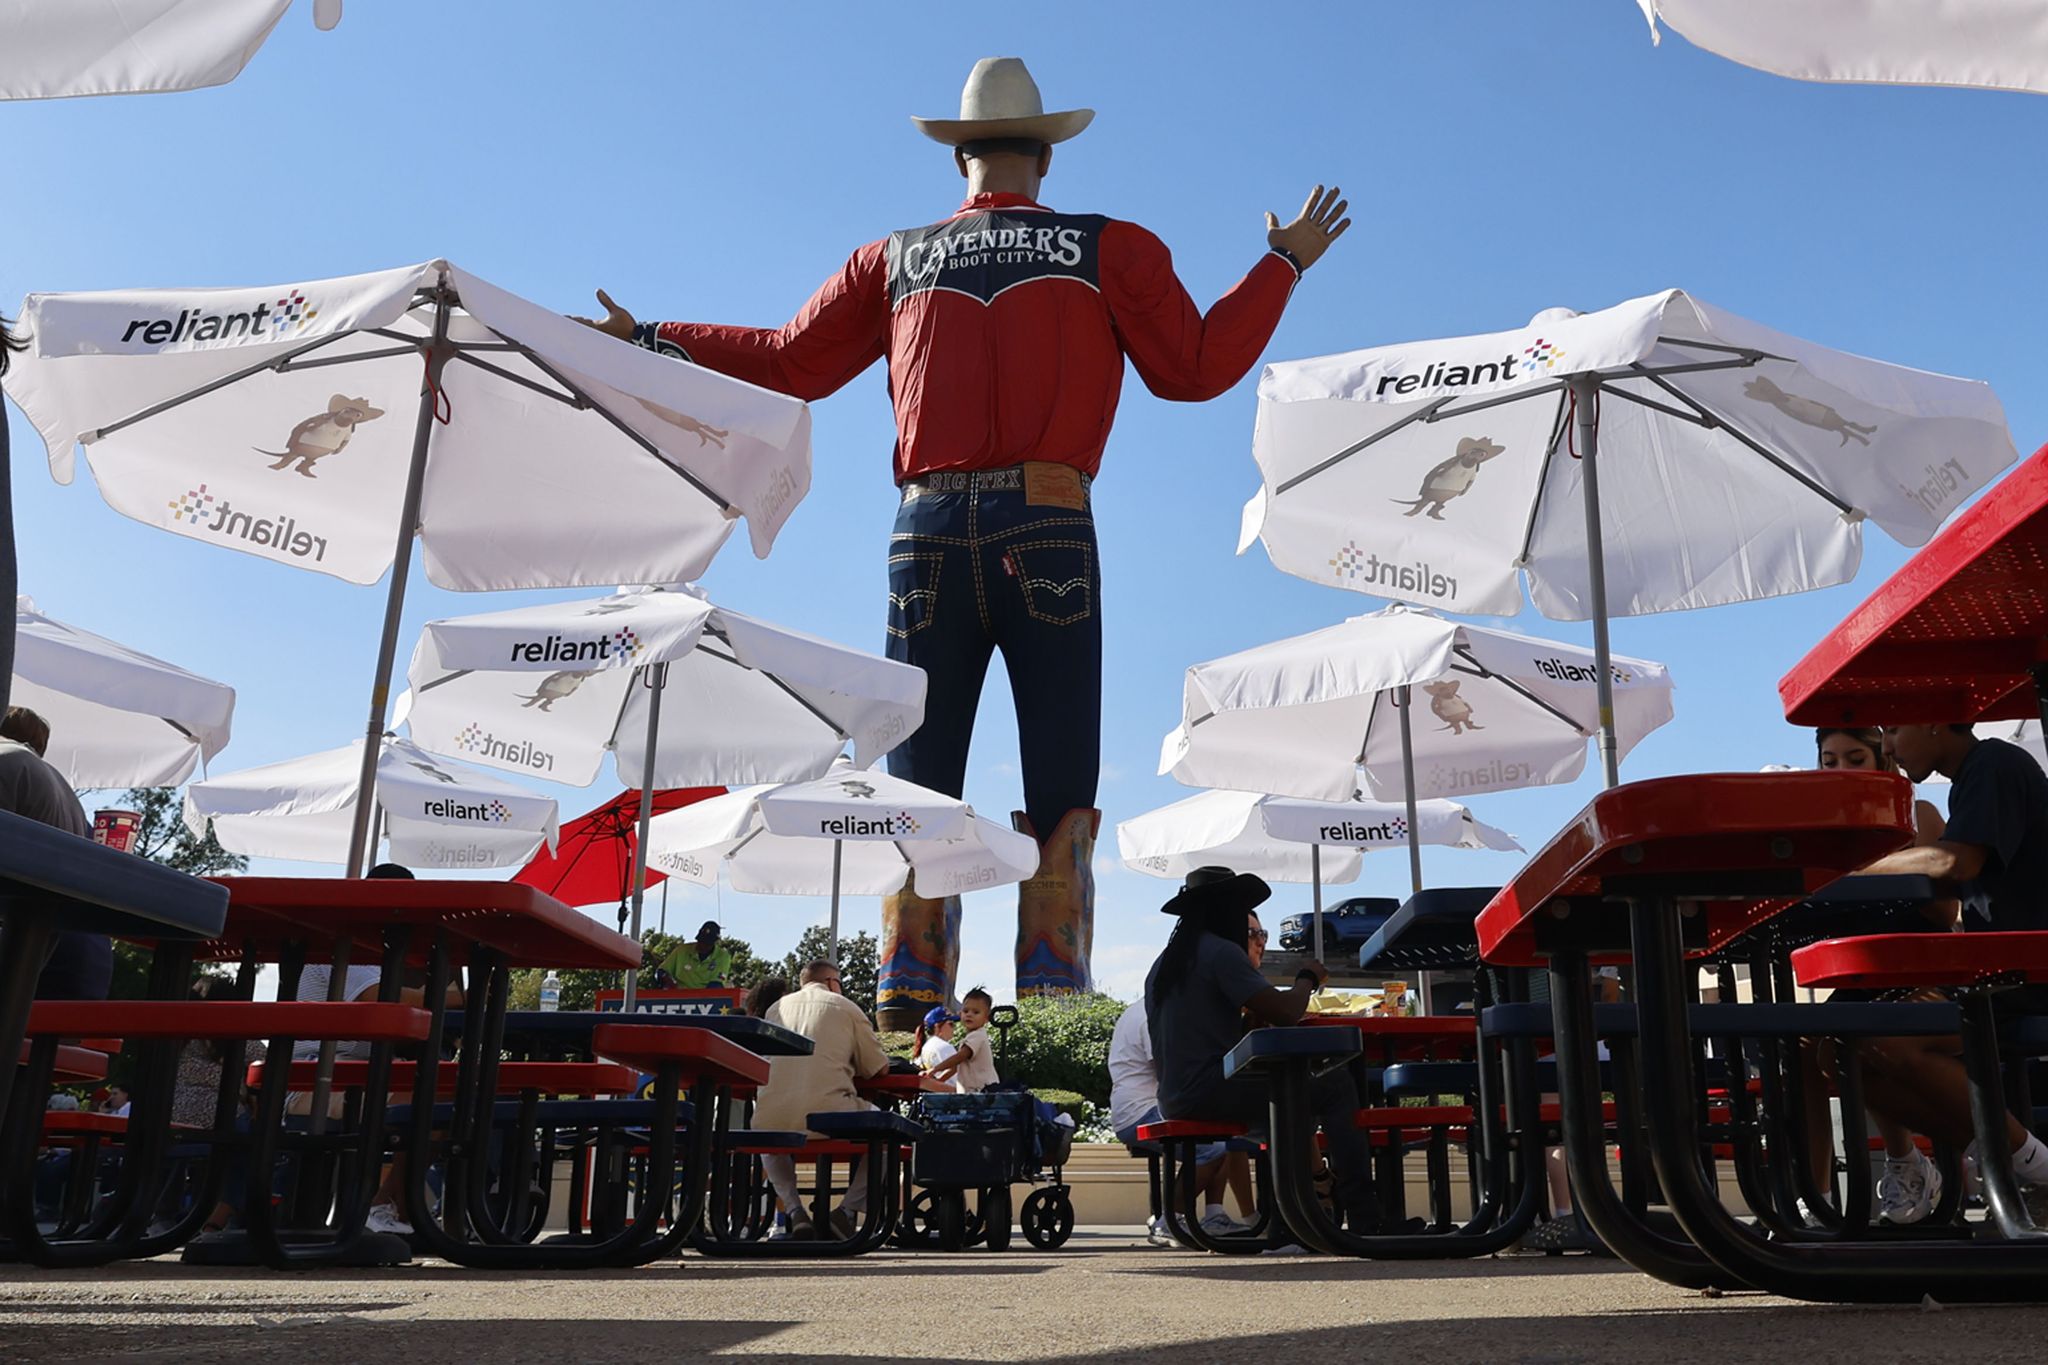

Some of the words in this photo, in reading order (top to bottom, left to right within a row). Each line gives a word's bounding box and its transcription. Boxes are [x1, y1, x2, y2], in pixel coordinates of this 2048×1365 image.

[905, 225, 1082, 281] CAVENDER'S
[949, 252, 991, 270] BOOT
[996, 251, 1036, 264] CITY
[121, 303, 270, 345] reliant
[1376, 354, 1519, 395] reliant
[928, 472, 967, 491] BIG
[979, 469, 1021, 489] TEX
[511, 635, 611, 662] reliant
[424, 799, 490, 821] reliant
[821, 815, 896, 835] reliant
[1320, 822, 1393, 841] reliant
